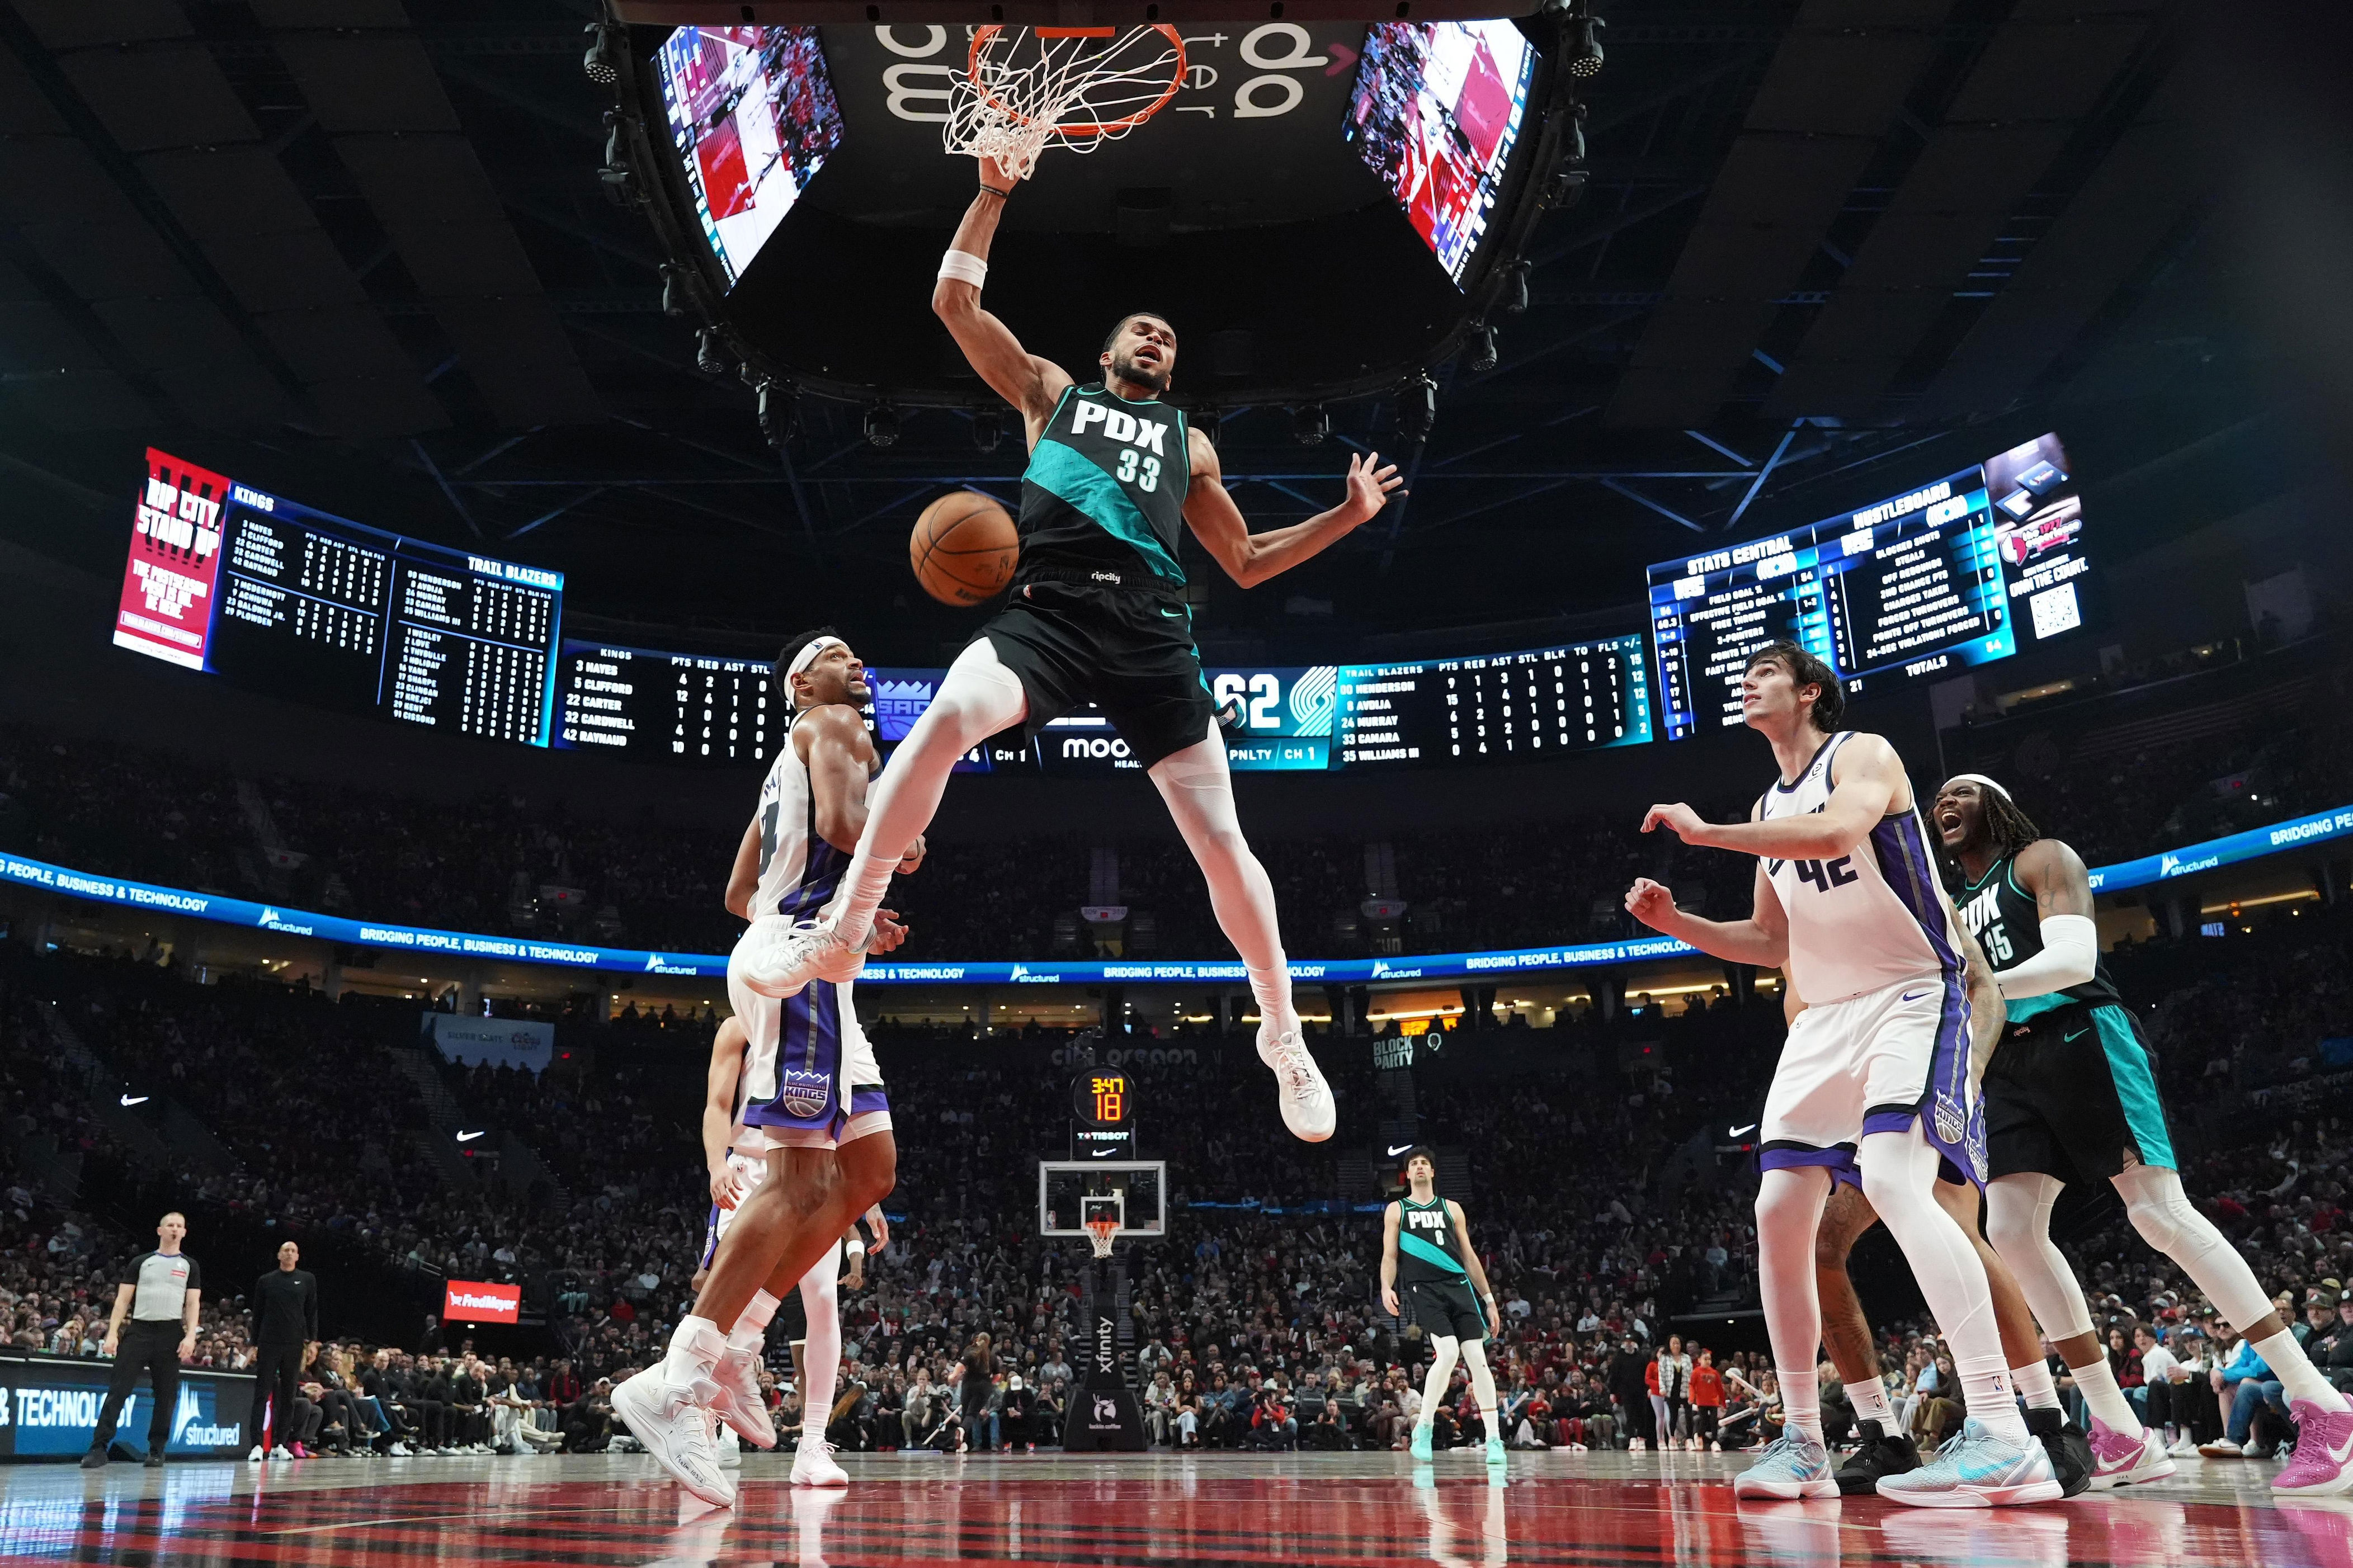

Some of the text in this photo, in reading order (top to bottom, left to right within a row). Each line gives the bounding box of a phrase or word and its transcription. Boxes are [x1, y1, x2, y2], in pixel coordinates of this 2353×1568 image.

[1071, 399, 1168, 457] PDX
[1116, 448, 1161, 493] 33
[145, 477, 220, 532] RIP CITY.
[234, 486, 274, 512] KINGS
[1853, 481, 1951, 530] HUSTLEBOARD
[136, 504, 220, 557] STAND UP
[249, 522, 272, 536] HAYES
[246, 541, 275, 556] CARTER
[247, 531, 284, 549] CLIFFORD
[244, 550, 284, 569] CARDWELL
[1687, 535, 1793, 575] STATS CENTRAL
[243, 560, 277, 577] RAYNAUD
[468, 556, 557, 587] TRAIL BLAZERS
[2009, 577, 2035, 597] OWN
[2033, 570, 2053, 587] THE
[2053, 557, 2089, 582] COURT.
[418, 573, 461, 590] HENDERSON
[1091, 572, 1121, 584] ripcity
[416, 591, 446, 604] MURRAY
[414, 608, 450, 624] WILLIAMS
[601, 648, 632, 660] KINGS
[1439, 662, 1459, 672] PTS
[1464, 659, 1486, 670] REB
[1492, 656, 1511, 667] AST
[1519, 654, 1538, 664] STL
[1544, 649, 1565, 660] BLK
[1574, 646, 1588, 656] TO
[1598, 642, 1619, 653] FLS
[576, 660, 618, 676] 3 HAYES
[671, 657, 770, 674] PTS REB AST STL
[1378, 665, 1423, 676] BLAZERS
[1906, 655, 1948, 677] TOTALS
[574, 677, 633, 695] 5 CLIFFORD
[1340, 681, 1415, 695] 00 HENDERSON
[1850, 679, 1862, 693] 21
[567, 693, 622, 711] 22 CARTER
[1214, 674, 1280, 729] 62
[1347, 701, 1354, 711] 8
[565, 711, 635, 730] 32 CARDWELL
[1341, 715, 1398, 728] 24 MURRAY
[563, 728, 627, 747] 42 RAYNAUD
[1342, 732, 1400, 745] 33 CAMARA
[969, 748, 980, 762] 4
[996, 749, 1026, 762] CH 1
[1229, 749, 1272, 761] PNLTY
[1284, 747, 1314, 761] CH 1
[1343, 750, 1356, 762] 35
[1359, 749, 1407, 761] WILLIAMS
[2270, 818, 2333, 846] BRIDGING
[1794, 854, 1859, 892] 42
[2171, 856, 2219, 877] structured
[7, 861, 54, 886] PEOPLE,
[56, 873, 114, 897] BUSINESS
[116, 886, 125, 899] &
[129, 887, 208, 912] TECHNOLOGY
[268, 920, 313, 936] structured
[360, 927, 598, 964] BRIDGING PEOPLE, BUSINESS & TECHNOLOGY
[1984, 923, 2014, 966] 35
[1466, 956, 1516, 970] BRIDGING
[1519, 952, 1562, 966] PEOPLE,
[1564, 948, 1615, 962] BUSINESS
[1617, 947, 1625, 958] &
[654, 965, 696, 975] structured
[888, 968, 895, 979] &
[898, 968, 965, 979] TECHNOLOGY
[1019, 974, 1059, 983] structured
[1104, 967, 1152, 978] BRIDGING
[1154, 967, 1196, 978] PEOPLE,
[1197, 966, 1246, 977] BUSINESS
[1380, 969, 1421, 979] structured
[1373, 1036, 1413, 1055] BLOCK
[786, 1087, 826, 1100] KINGS
[1092, 1078, 1123, 1094] 3:47
[1097, 1094, 1121, 1121] 18
[1939, 1103, 1963, 1123] SACRAMENTO
[1936, 1109, 1962, 1132] KINGS
[1091, 1132, 1129, 1140] TISSOT
[1408, 1211, 1446, 1229] PDX
[1435, 1230, 1444, 1245] 8
[1096, 1316, 1114, 1373] xfinity
[185, 1423, 240, 1446] structured
